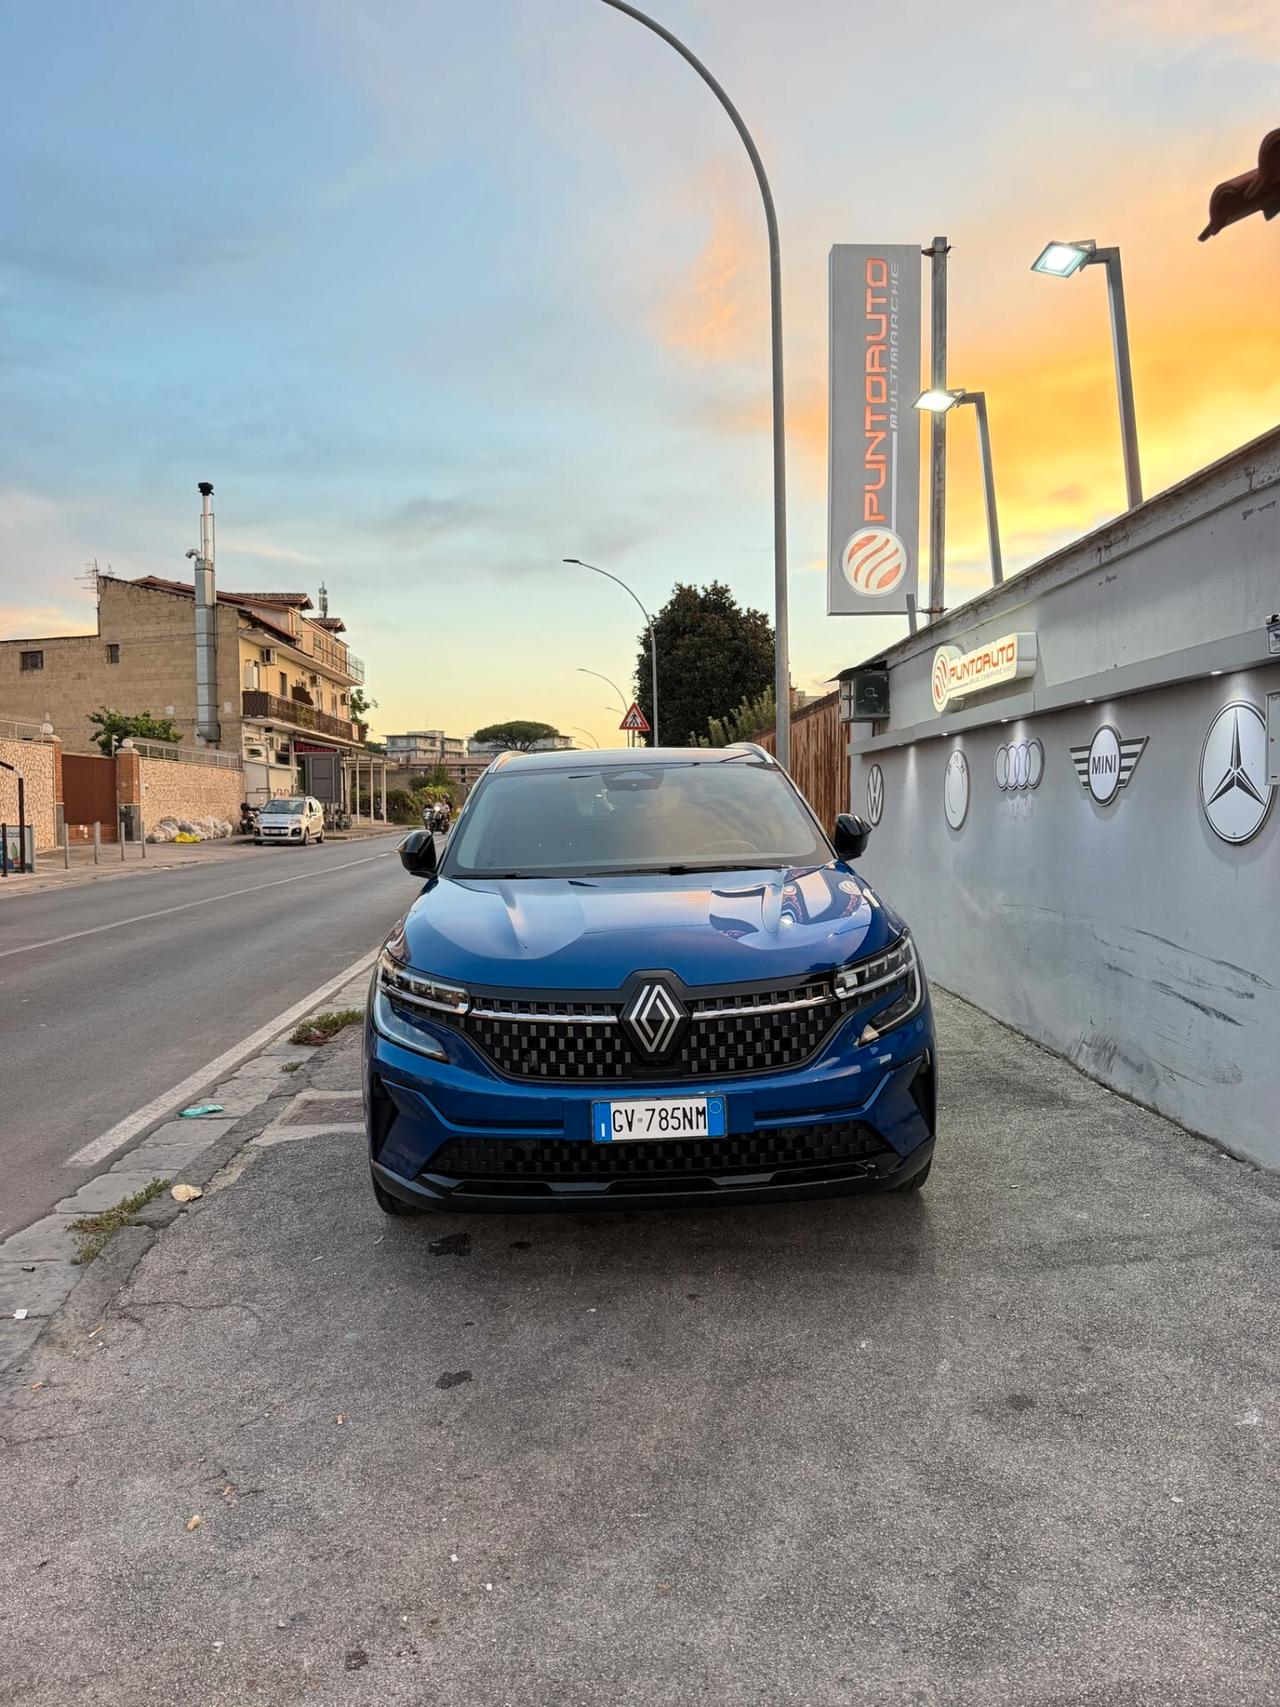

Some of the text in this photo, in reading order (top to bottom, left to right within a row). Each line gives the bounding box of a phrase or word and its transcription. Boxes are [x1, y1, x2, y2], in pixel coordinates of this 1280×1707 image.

[864, 257, 888, 521] PUNTOAUTO
[889, 263, 899, 430] MULTIMARCHE
[949, 642, 1015, 684] PUNTOAUTO
[1092, 754, 1116, 775] MINI
